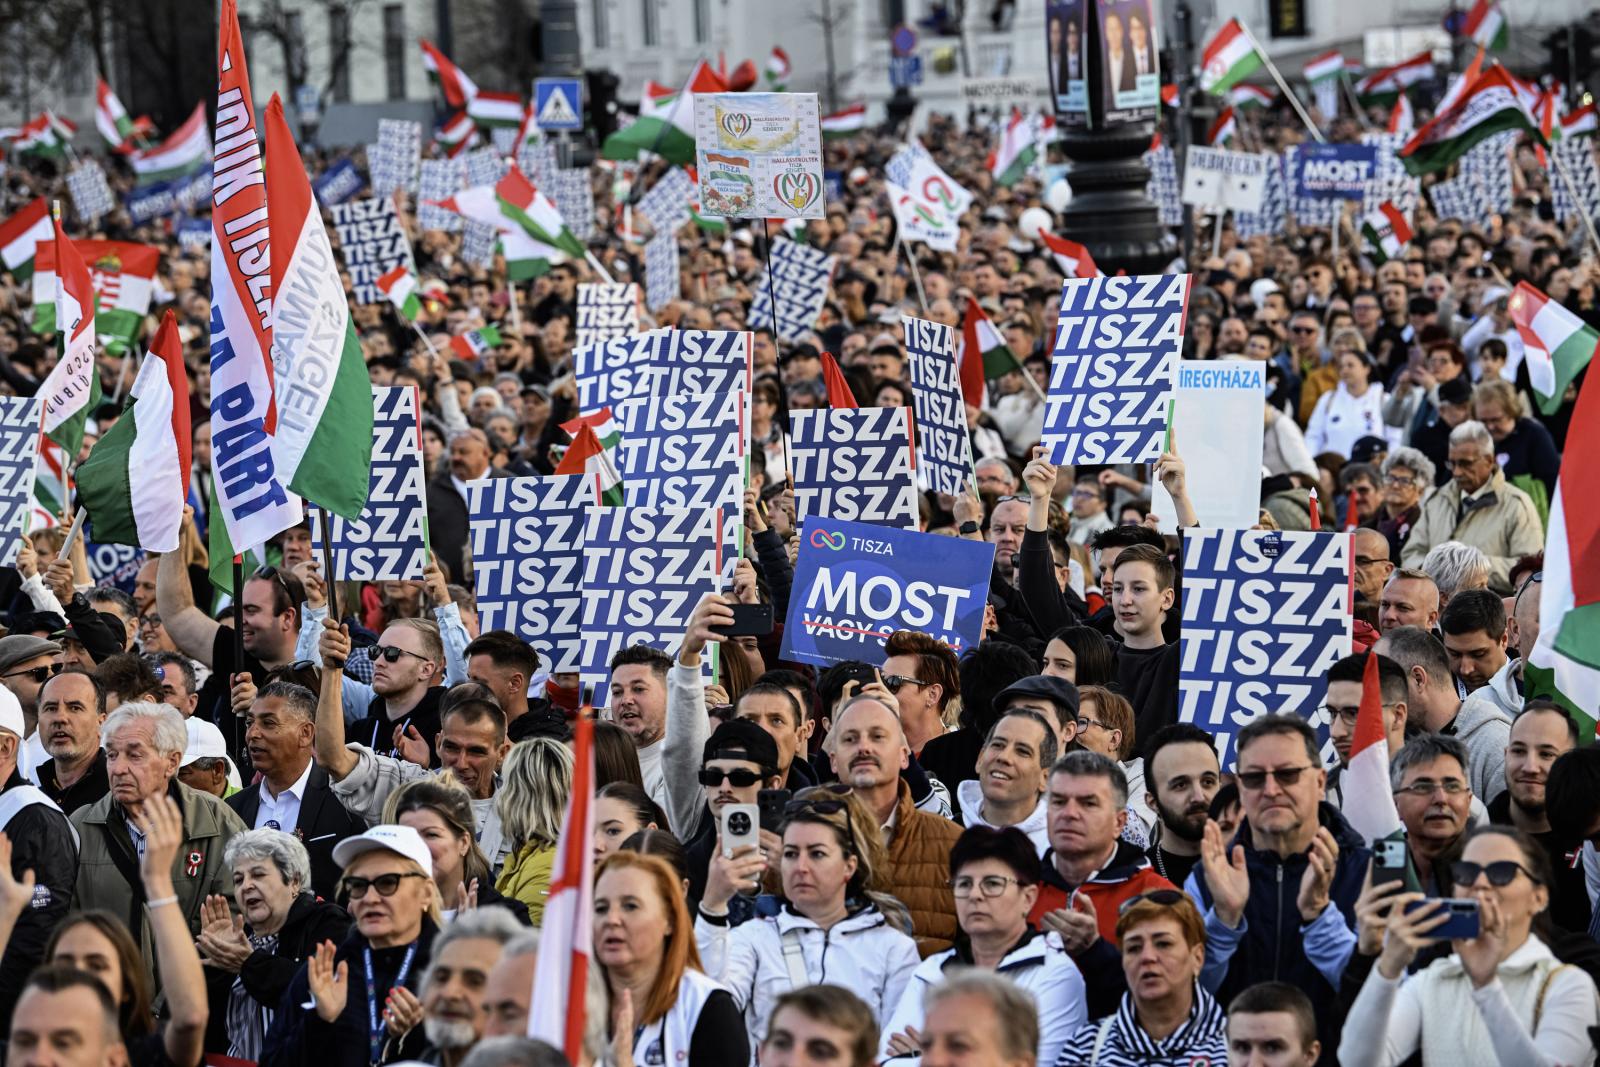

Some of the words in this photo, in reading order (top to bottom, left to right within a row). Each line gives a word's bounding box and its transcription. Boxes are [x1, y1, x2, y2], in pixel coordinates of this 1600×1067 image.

[719, 163, 740, 174] TISZA
[1303, 160, 1371, 180] MOST
[329, 198, 396, 225] TISZA
[336, 217, 403, 245] TISZA
[342, 238, 408, 265] TISZA
[771, 236, 837, 270] TISZA
[758, 271, 825, 303] TISZA
[765, 253, 831, 287] TISZA
[577, 283, 638, 305] TISZA
[751, 291, 819, 321] TISZA
[1061, 274, 1187, 311] TISZA
[577, 305, 638, 328] TISZA
[1055, 312, 1182, 350] TISZA
[572, 331, 650, 375] TISZ
[648, 330, 747, 364] TISZA
[902, 317, 955, 357] TISZA
[575, 363, 650, 408] TISZ
[648, 367, 747, 397] TISZA
[906, 352, 961, 393] TISZA
[1050, 351, 1176, 389] TISZA
[1178, 365, 1261, 388] ÍREGYHÁZA
[624, 392, 740, 432] TISZA
[789, 408, 909, 442] TISZA
[911, 387, 966, 430] TISZA
[1044, 391, 1170, 428] TISZA
[624, 432, 740, 474] TISZA
[791, 446, 912, 482] TISZA
[917, 424, 971, 468] TISZA
[1040, 431, 1166, 465] TISZA
[466, 474, 597, 514] TISZA
[623, 475, 740, 508] TISZA
[793, 486, 914, 521] TISZA
[309, 507, 425, 543] TISZA
[469, 515, 584, 556] TISZ
[584, 506, 717, 543] TISZA
[312, 548, 427, 581] TISZA
[852, 537, 893, 556] TISZA
[1184, 528, 1348, 576] TISZA
[472, 556, 583, 597] TISZ
[583, 547, 716, 585] TISZA
[476, 597, 581, 636] TISZ
[805, 567, 971, 631] MOST
[1182, 577, 1347, 627] TISZA
[802, 612, 874, 643] VAGY
[1180, 628, 1346, 677] TISZA
[1178, 680, 1328, 728] TISZ
